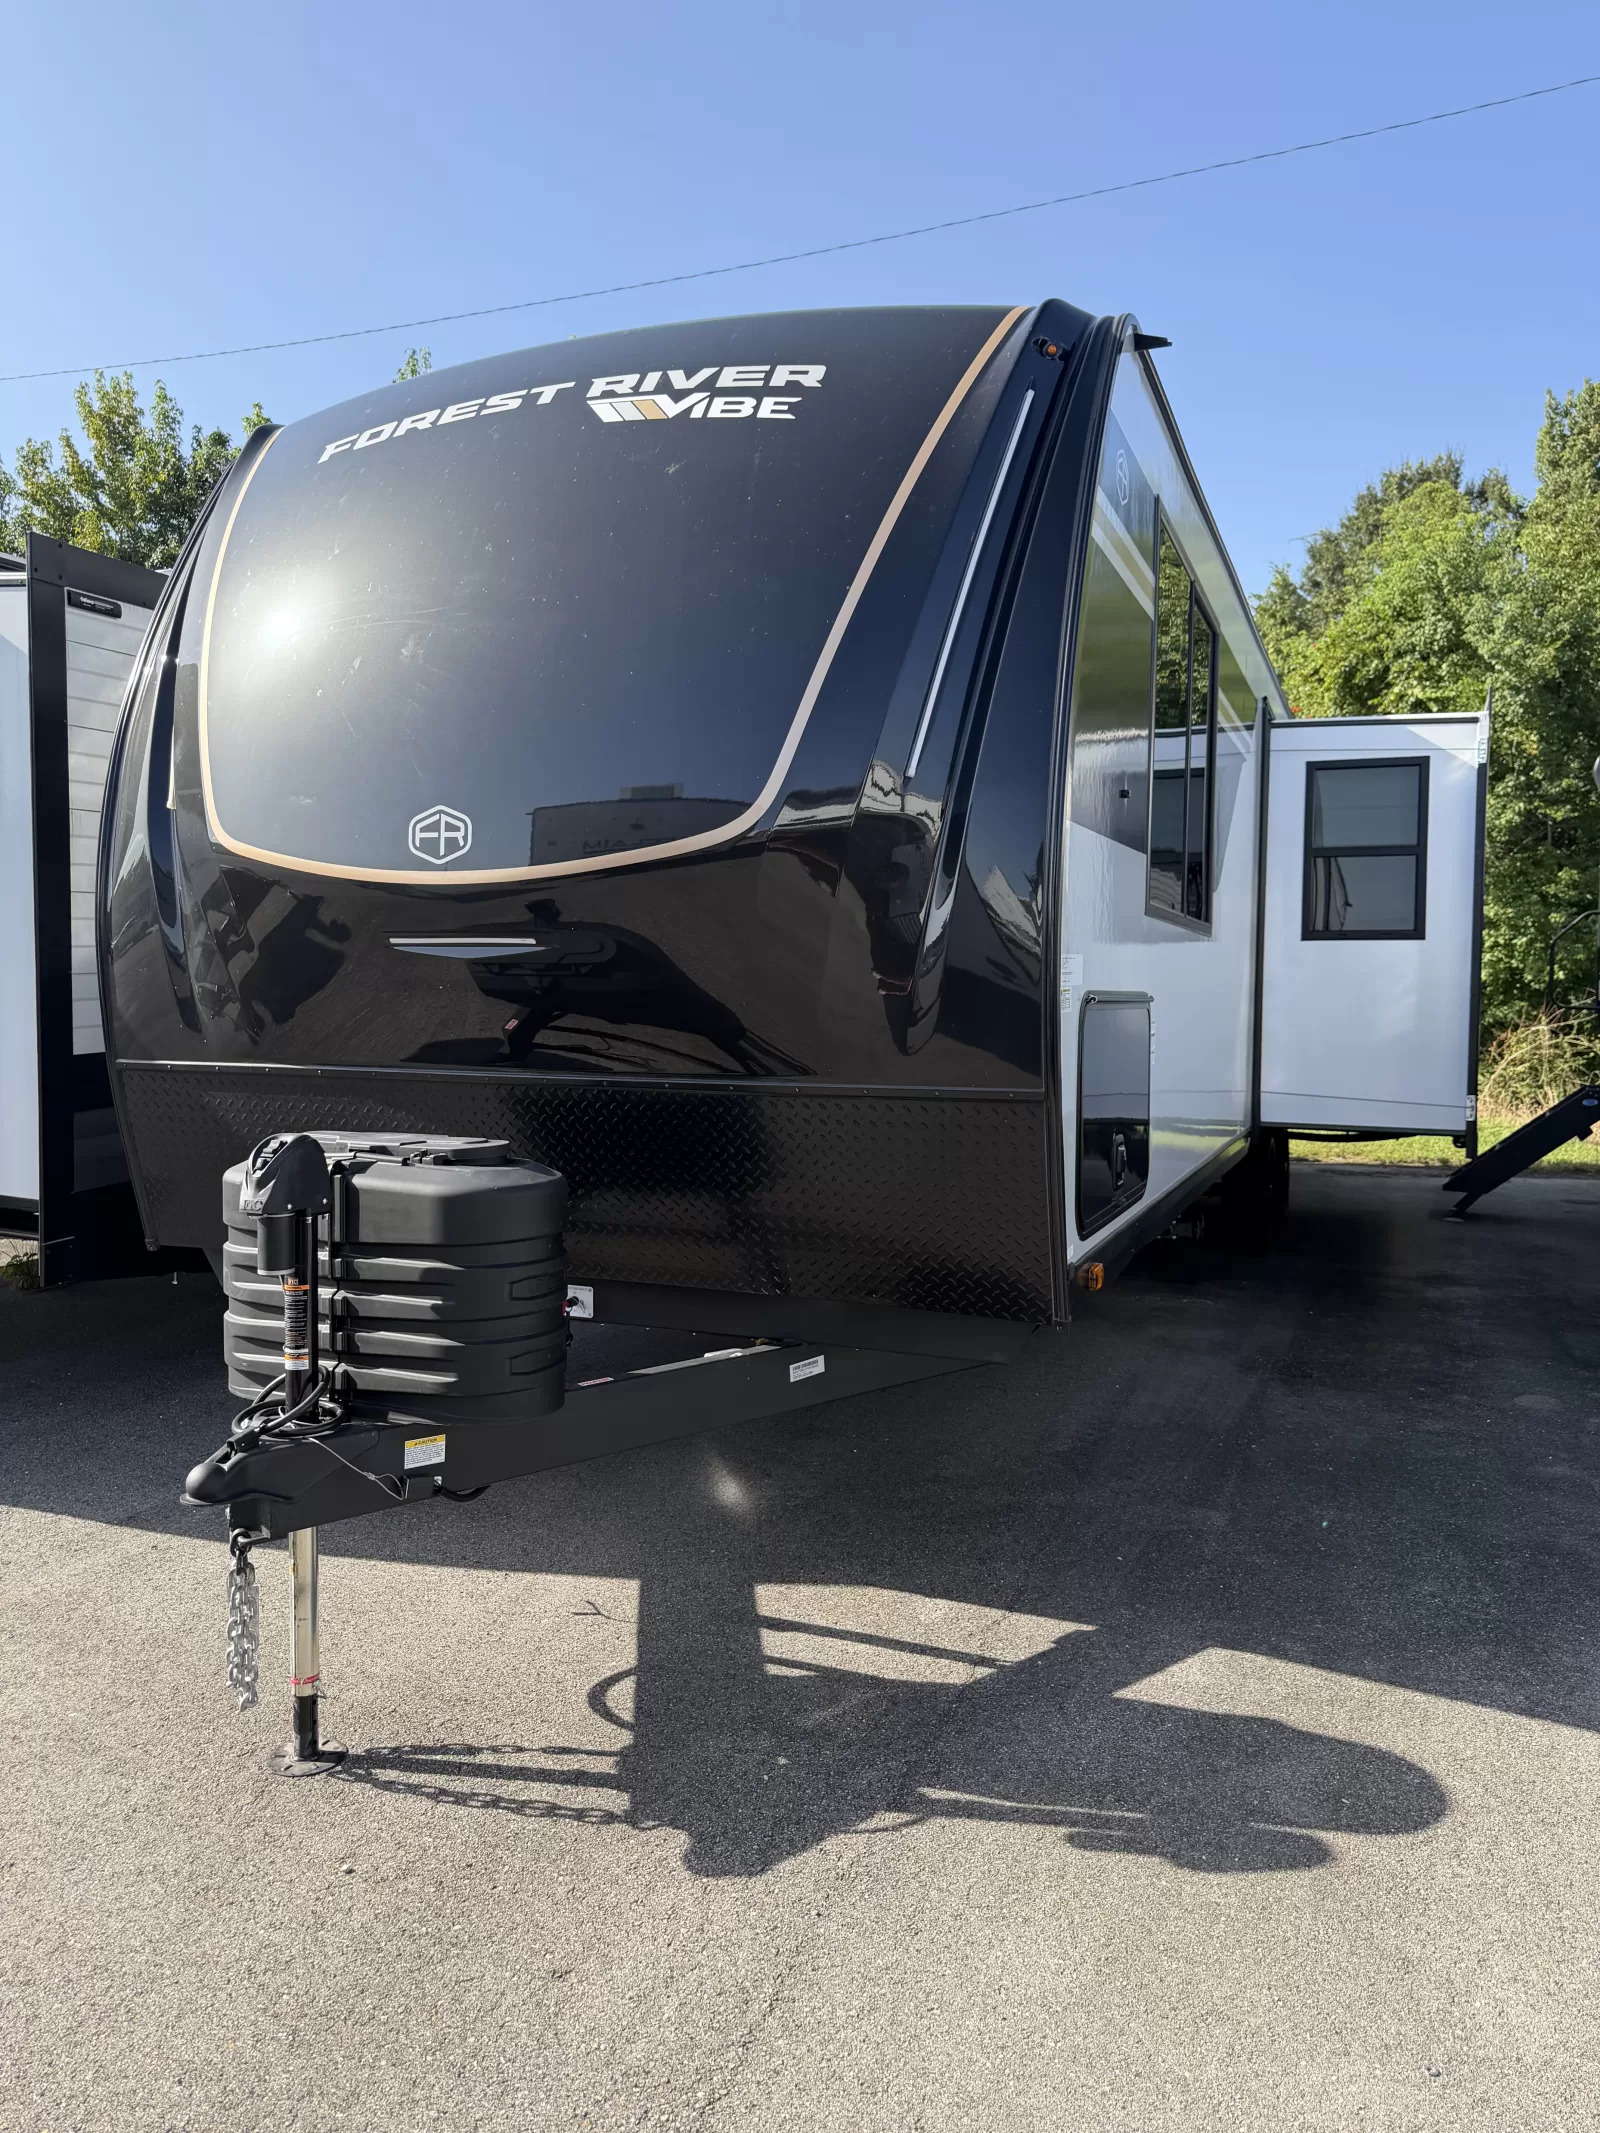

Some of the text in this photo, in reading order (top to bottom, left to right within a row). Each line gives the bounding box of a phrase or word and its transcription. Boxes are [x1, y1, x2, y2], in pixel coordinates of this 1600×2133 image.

[317, 364, 827, 464] FOREST RIVER
[655, 393, 802, 420] VIBE
